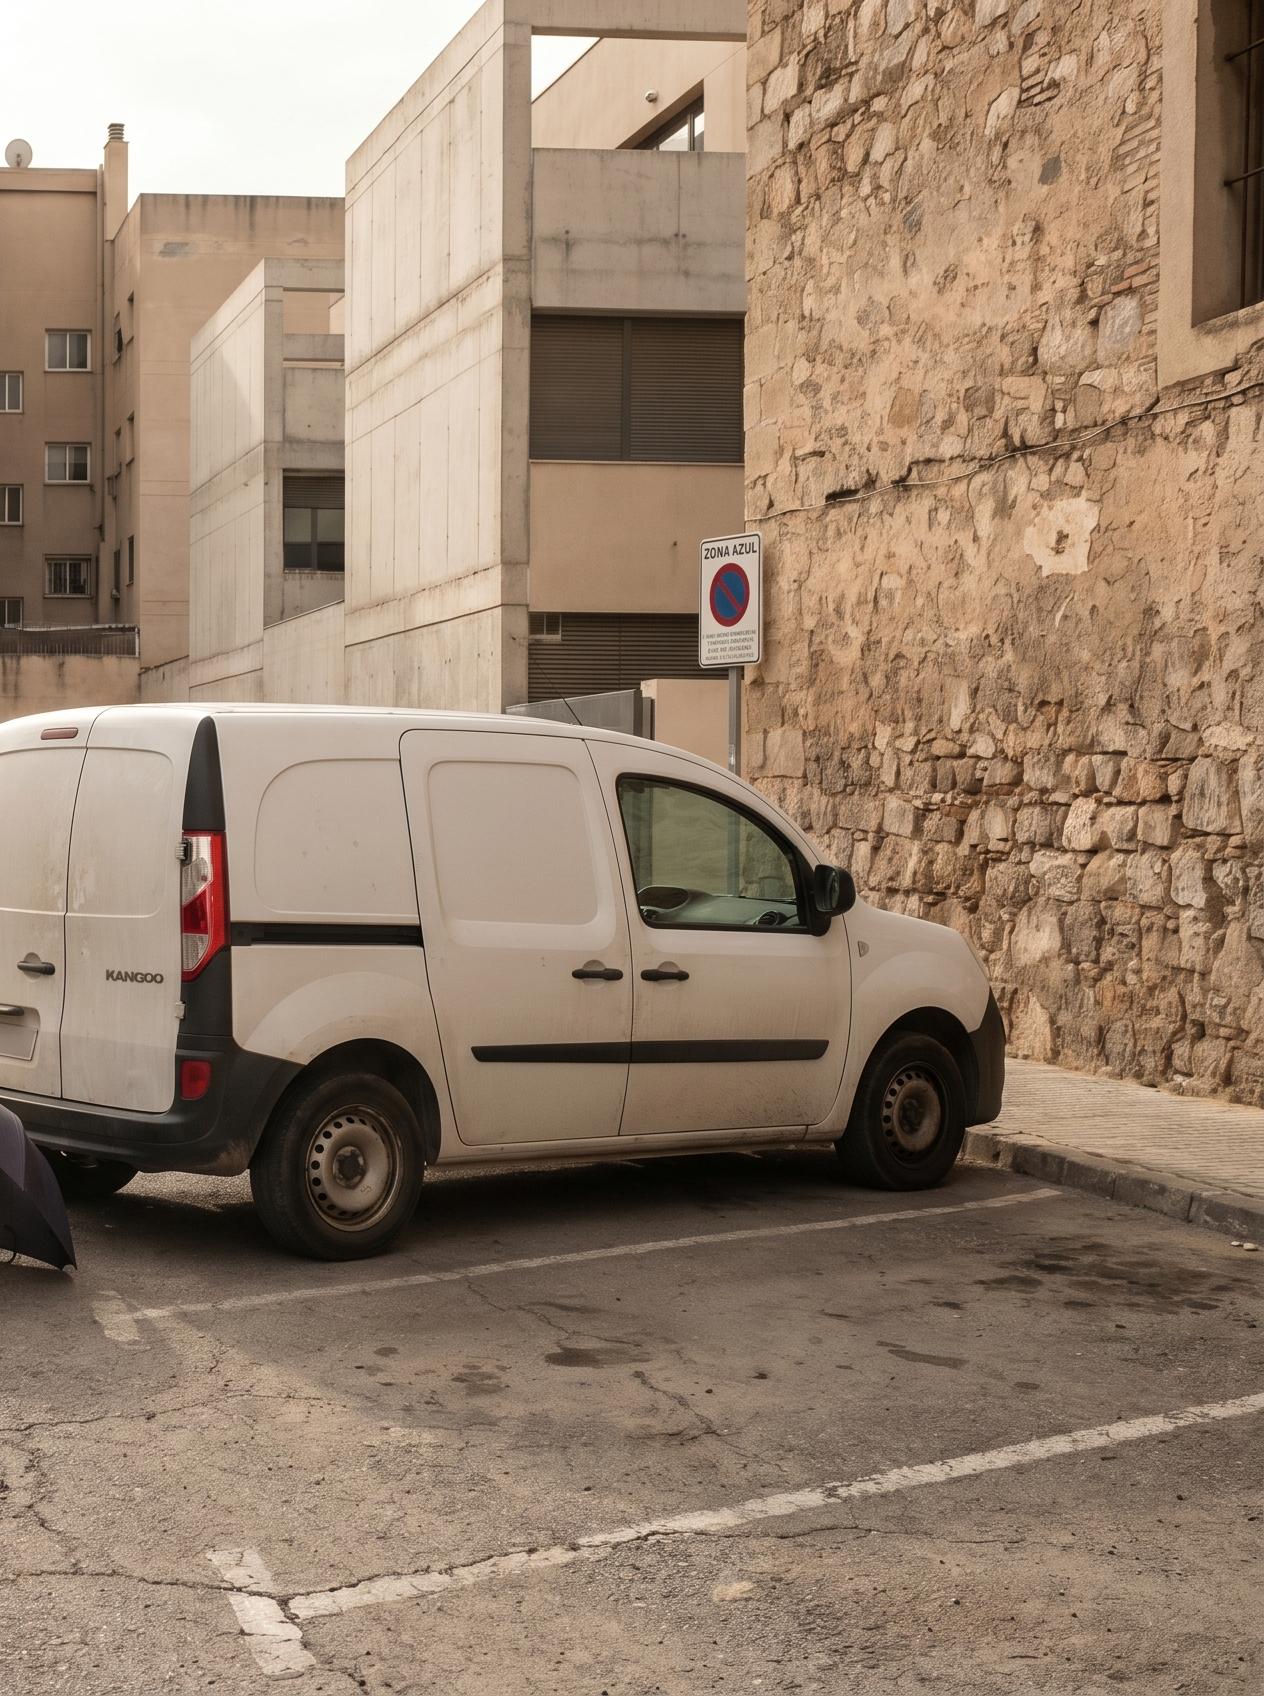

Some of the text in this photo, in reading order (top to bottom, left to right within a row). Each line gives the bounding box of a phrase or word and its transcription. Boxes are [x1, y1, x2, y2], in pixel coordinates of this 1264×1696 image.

[704, 542, 757, 560] ZONA AZUL
[105, 969, 164, 984] KANGOO
